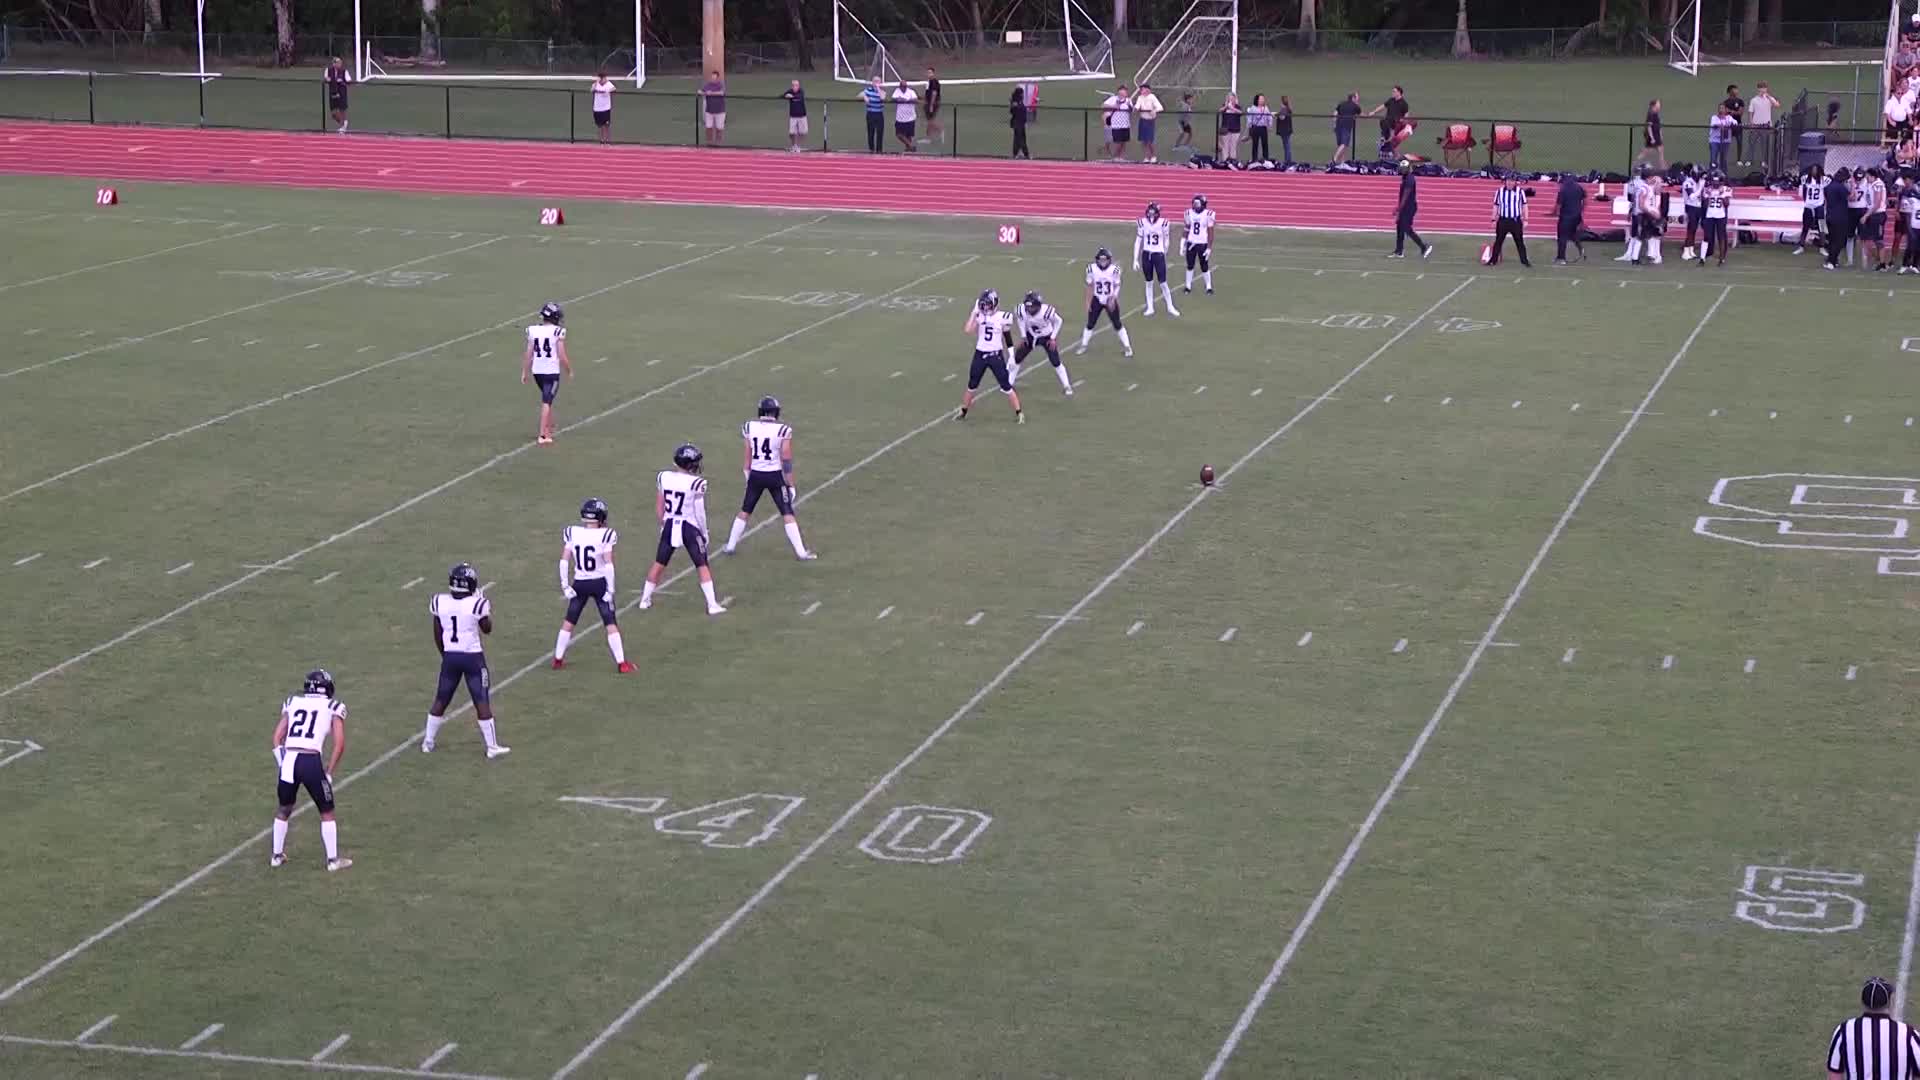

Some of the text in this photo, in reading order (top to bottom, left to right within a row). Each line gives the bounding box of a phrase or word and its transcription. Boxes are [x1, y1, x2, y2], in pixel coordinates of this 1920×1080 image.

[96, 189, 113, 205] 10
[1807, 187, 1820, 200] 42
[540, 207, 558, 225] 20
[999, 226, 1017, 243] 30
[1193, 221, 1201, 235] 8
[1146, 234, 1160, 246] 13
[1095, 281, 1112, 295] 23
[984, 326, 994, 342] 5
[533, 337, 552, 358] 44
[752, 437, 772, 460] 14
[663, 489, 686, 516] 57
[574, 545, 597, 572] 16
[450, 615, 459, 643] 1
[288, 708, 320, 740] 21
